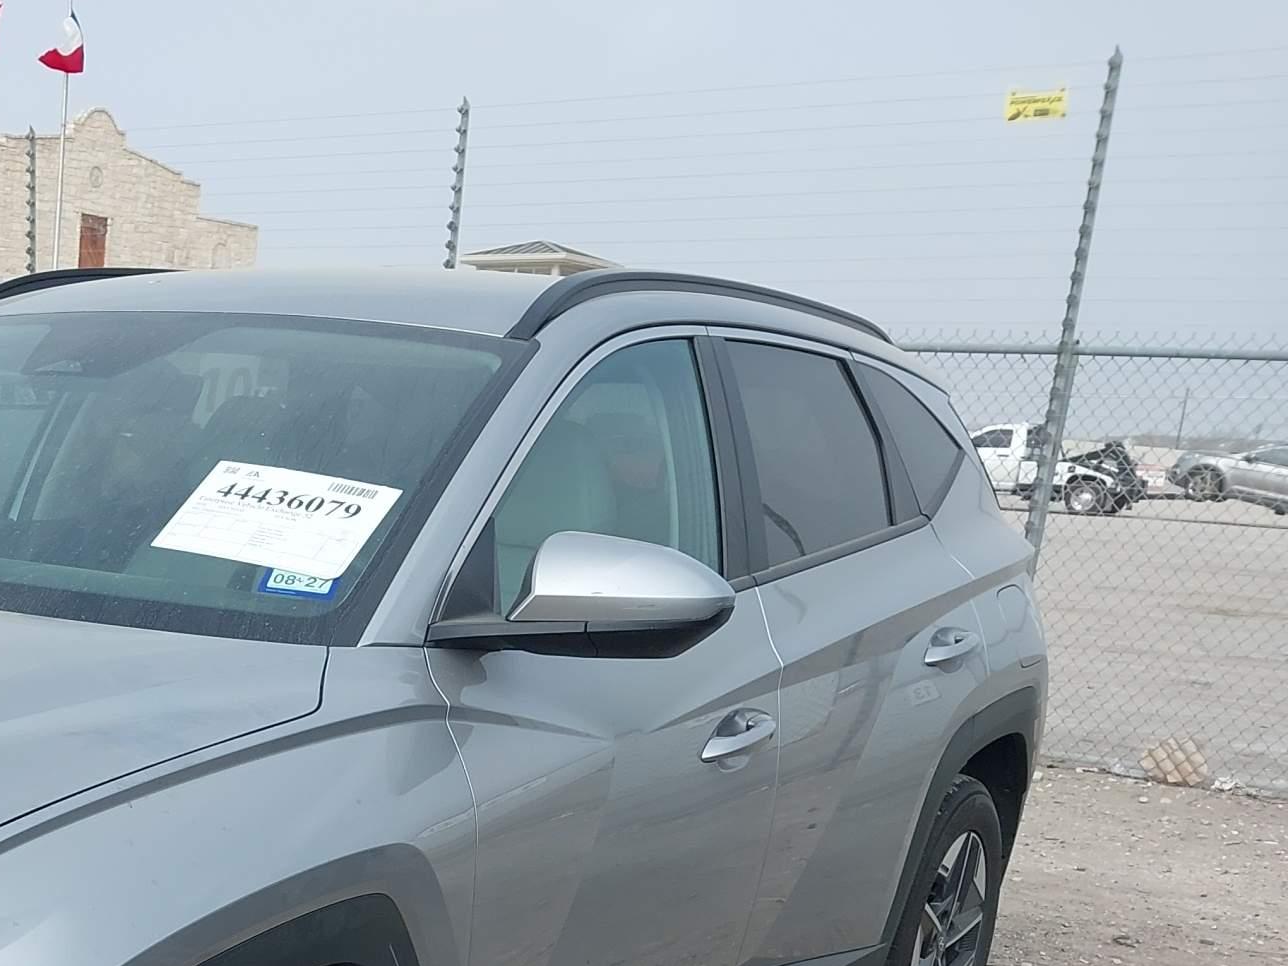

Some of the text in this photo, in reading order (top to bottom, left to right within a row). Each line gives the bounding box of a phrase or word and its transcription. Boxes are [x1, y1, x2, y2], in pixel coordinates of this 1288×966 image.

[216, 482, 362, 520] 44436079
[273, 573, 327, 589] 08 27
